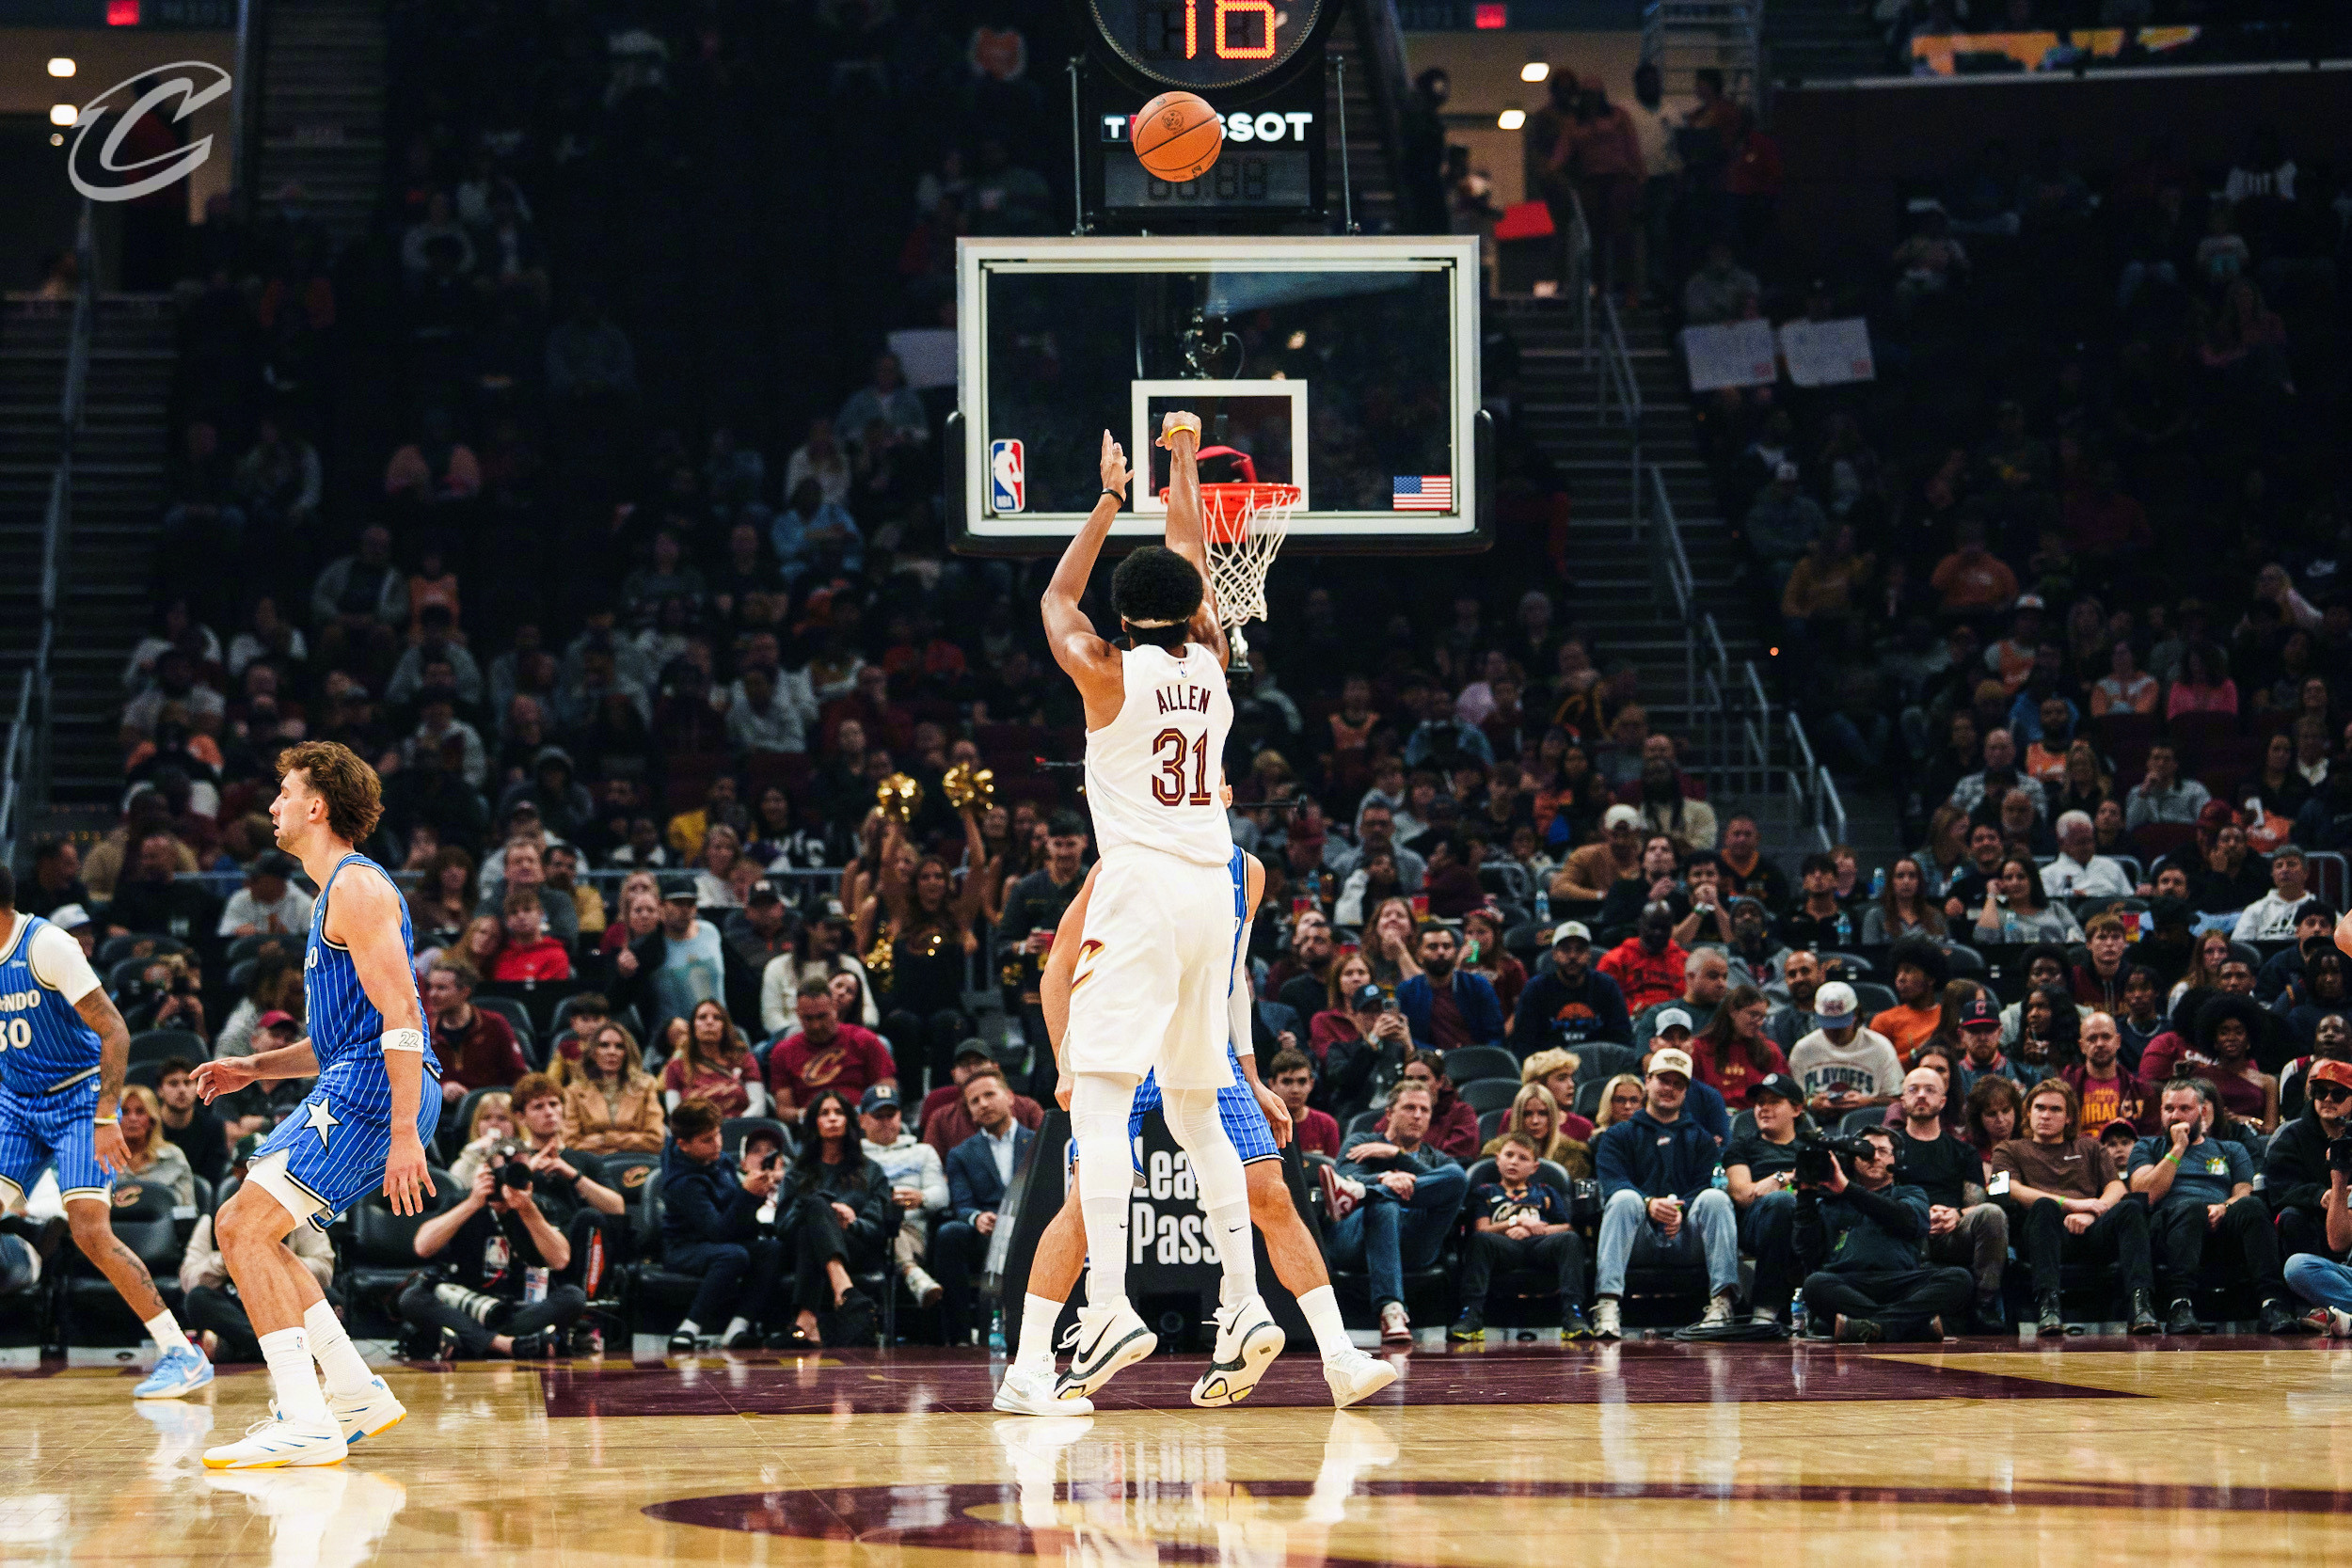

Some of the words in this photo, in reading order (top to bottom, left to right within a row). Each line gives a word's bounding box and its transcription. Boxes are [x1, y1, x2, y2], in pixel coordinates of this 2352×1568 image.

[1104, 111, 1313, 143] TSOT
[1155, 684, 1212, 716] ALLEN
[1152, 727, 1212, 807] 31
[398, 1031, 421, 1049] 22
[1132, 1135, 1206, 1212] Lea
[1132, 1201, 1222, 1265] Pass
